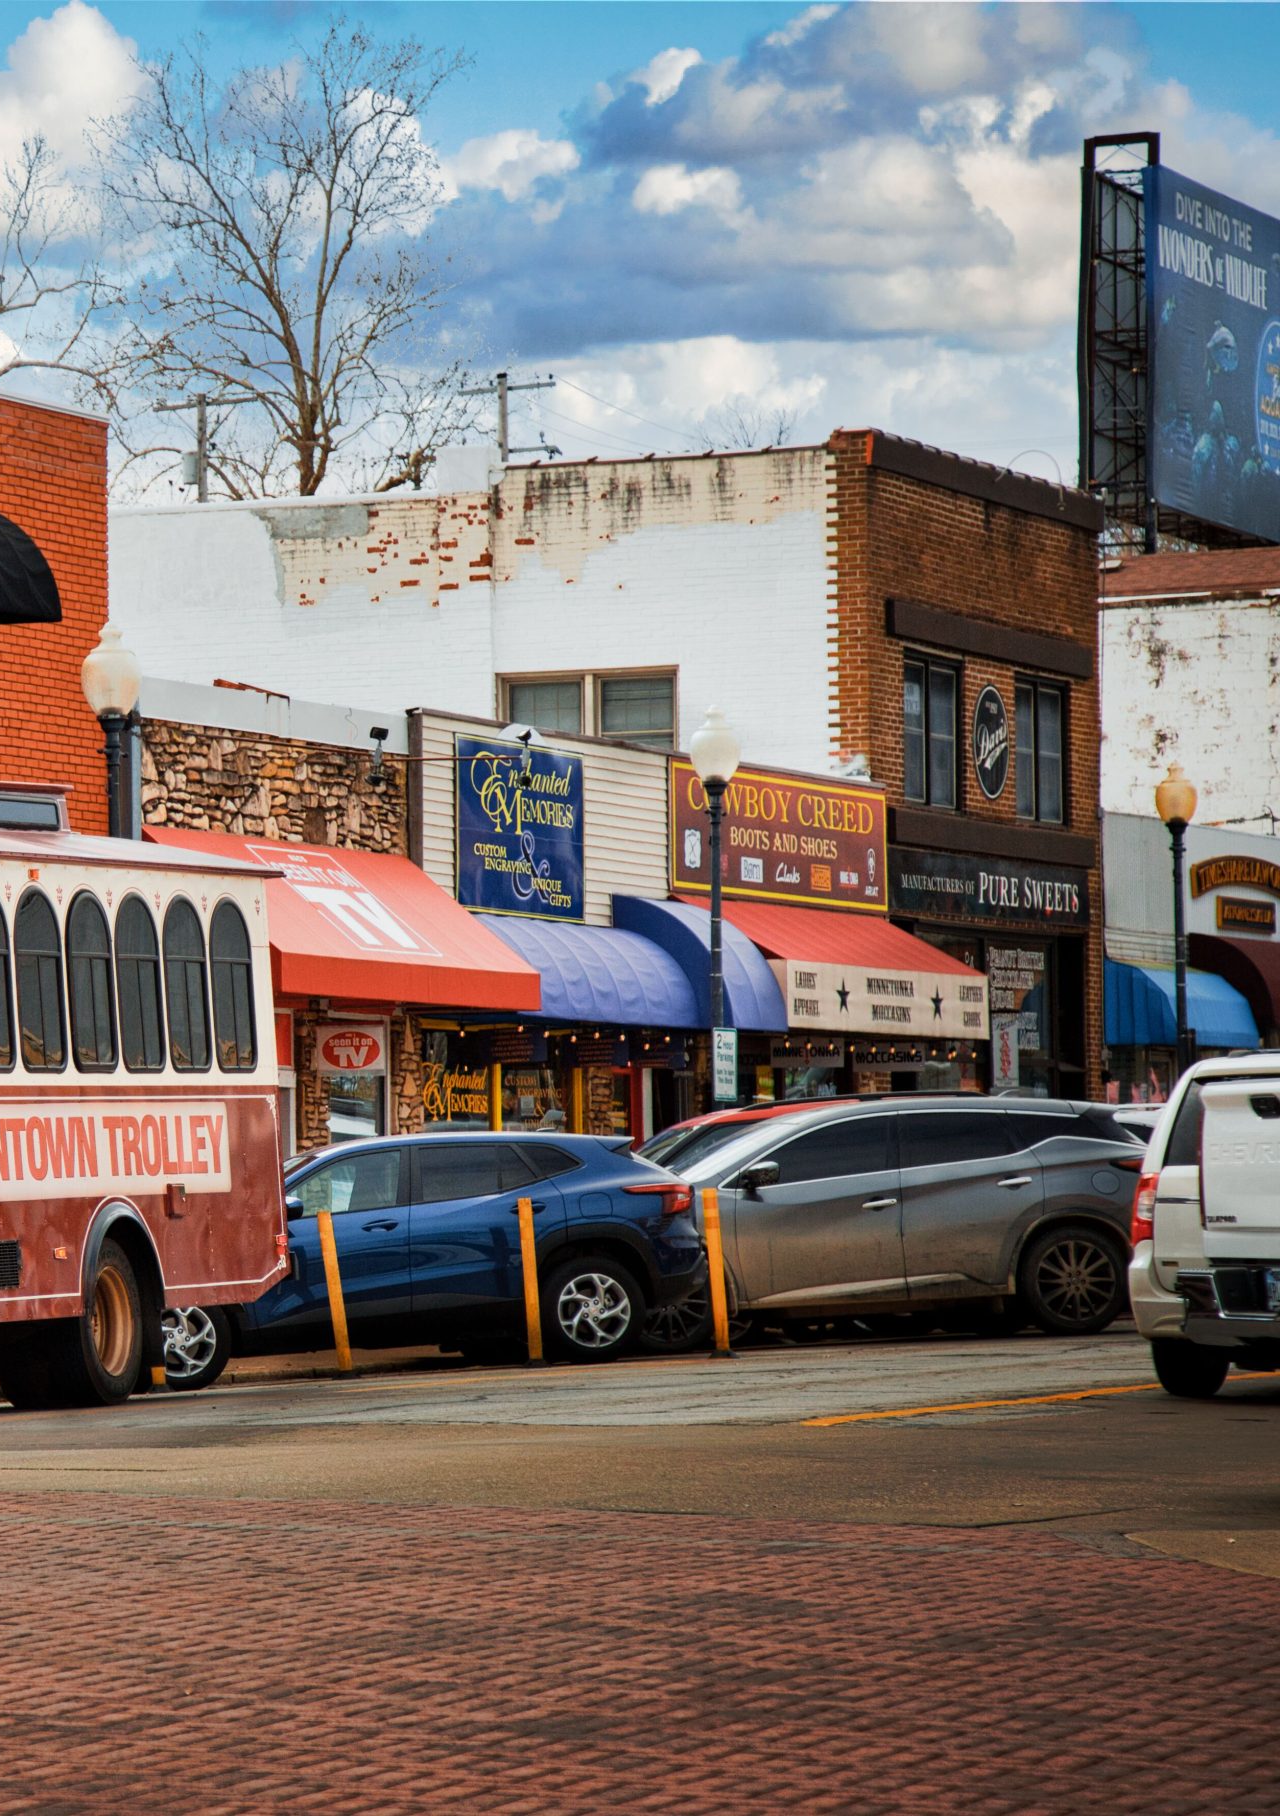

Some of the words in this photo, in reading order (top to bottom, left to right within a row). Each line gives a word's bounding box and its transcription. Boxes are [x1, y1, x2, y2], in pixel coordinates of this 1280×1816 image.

[1176, 192, 1202, 229] DIVE
[1204, 205, 1230, 242] INTO
[1232, 218, 1252, 252] THE
[1158, 224, 1214, 287] WONDERS
[1226, 254, 1268, 311] WILDLIFE
[481, 774, 574, 835] MEMORIES
[688, 776, 792, 824] CWBOY
[797, 794, 874, 834] CREED
[474, 842, 507, 858] CUSTOM
[730, 826, 770, 850] BOOTS
[773, 832, 798, 852] AND
[800, 836, 838, 860] SHOES
[484, 858, 532, 874] ENGRAVING
[512, 830, 550, 903] &
[776, 862, 800, 884] Clarks
[531, 878, 562, 892] UNIQUE
[901, 874, 964, 894] MANUFACTURERS
[965, 881, 974, 895] OF
[979, 872, 1020, 908] PURE
[1024, 877, 1079, 914] SWEETS
[549, 894, 572, 908] GIFTS
[294, 884, 420, 950] TV
[866, 978, 914, 998] MINNETONKA
[794, 998, 820, 1018] APPAREL
[872, 1004, 912, 1024] MOCCASINS
[717, 1034, 722, 1049] 2
[334, 1046, 368, 1066] TV
[773, 1044, 840, 1060] MINNETONKA
[855, 1051, 922, 1064] MOCCASINS
[422, 1062, 488, 1091] Enchanted
[504, 1074, 538, 1086] CUSTOM
[424, 1082, 488, 1122] MEMORIES
[518, 1088, 562, 1099] ENGRAVING
[102, 1114, 224, 1176] TROLLEY
